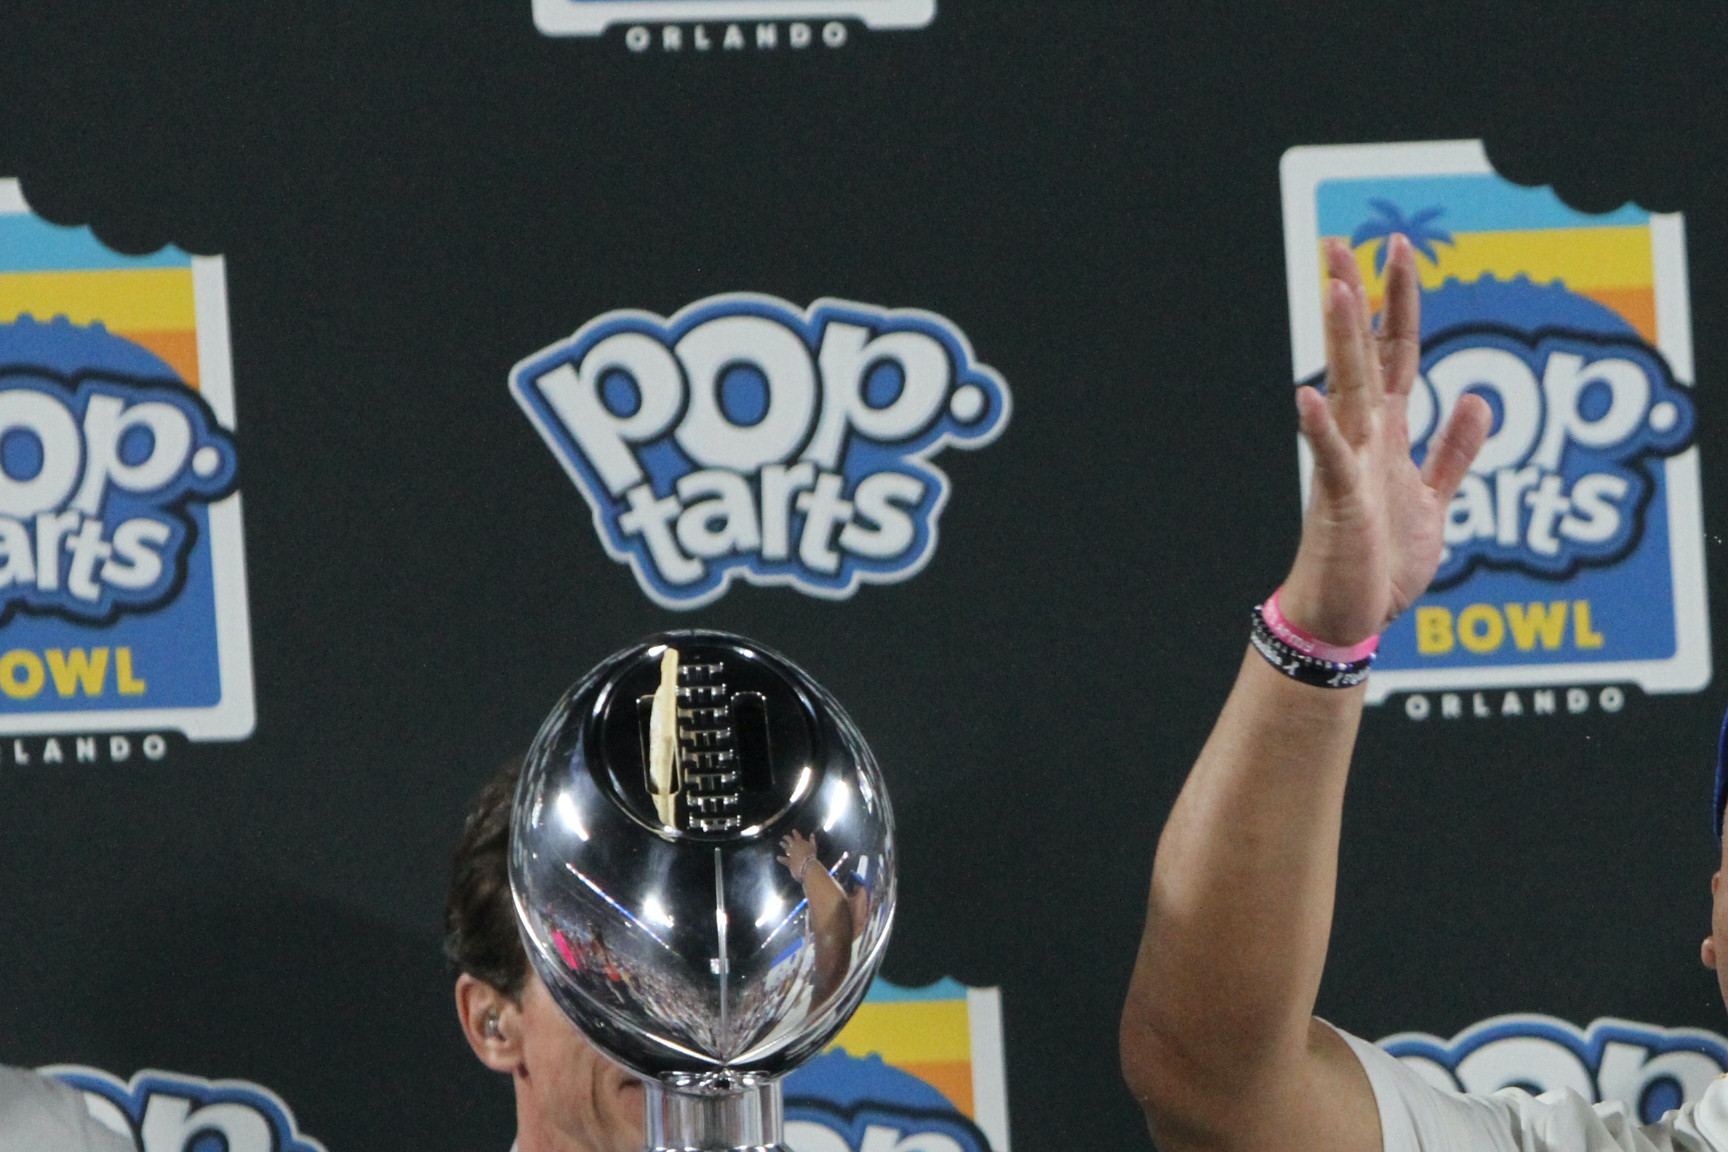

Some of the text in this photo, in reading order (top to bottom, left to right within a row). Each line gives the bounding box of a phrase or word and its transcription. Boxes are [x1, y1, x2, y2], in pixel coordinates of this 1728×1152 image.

[625, 22, 847, 51] ORLANDO
[1442, 465, 1630, 556] arts
[0, 509, 171, 602] arts
[1415, 601, 1604, 655] BOWL
[0, 646, 147, 698] OWL
[1405, 686, 1625, 721] ORLANDO
[13, 734, 168, 764] LANDO
